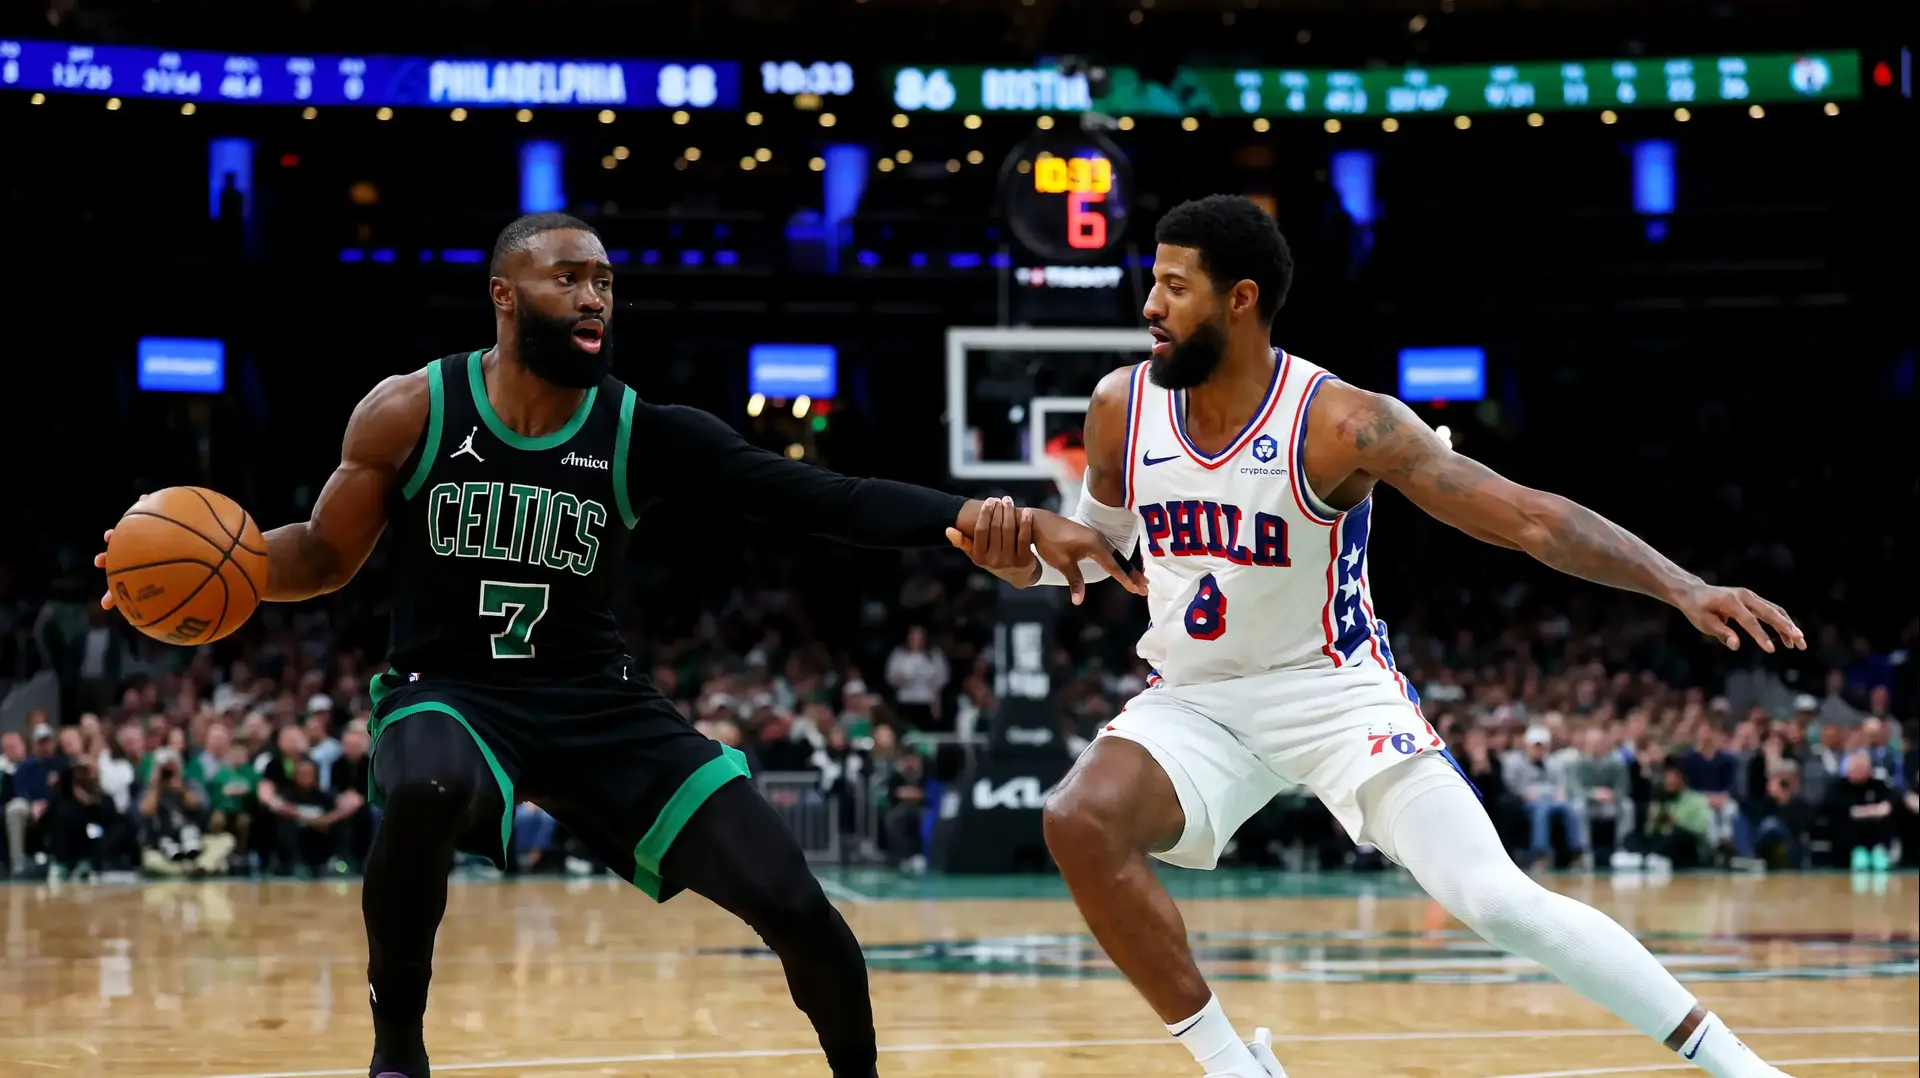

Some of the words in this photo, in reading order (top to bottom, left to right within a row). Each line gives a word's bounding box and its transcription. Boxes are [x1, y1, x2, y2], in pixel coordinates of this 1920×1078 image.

[429, 61, 626, 103] PHILADELPHIA
[657, 64, 717, 107] 88
[761, 61, 854, 95] 10:33
[894, 67, 956, 110] 86
[1067, 190, 1107, 249] 6
[561, 452, 609, 470] Amica
[1240, 466, 1288, 476] crypto.com
[428, 482, 607, 576] CELTICS
[1139, 500, 1291, 567] PHILA
[479, 580, 550, 659] 7
[1184, 573, 1227, 641] 8
[1367, 732, 1416, 757] 76
[973, 776, 1059, 810] KI
